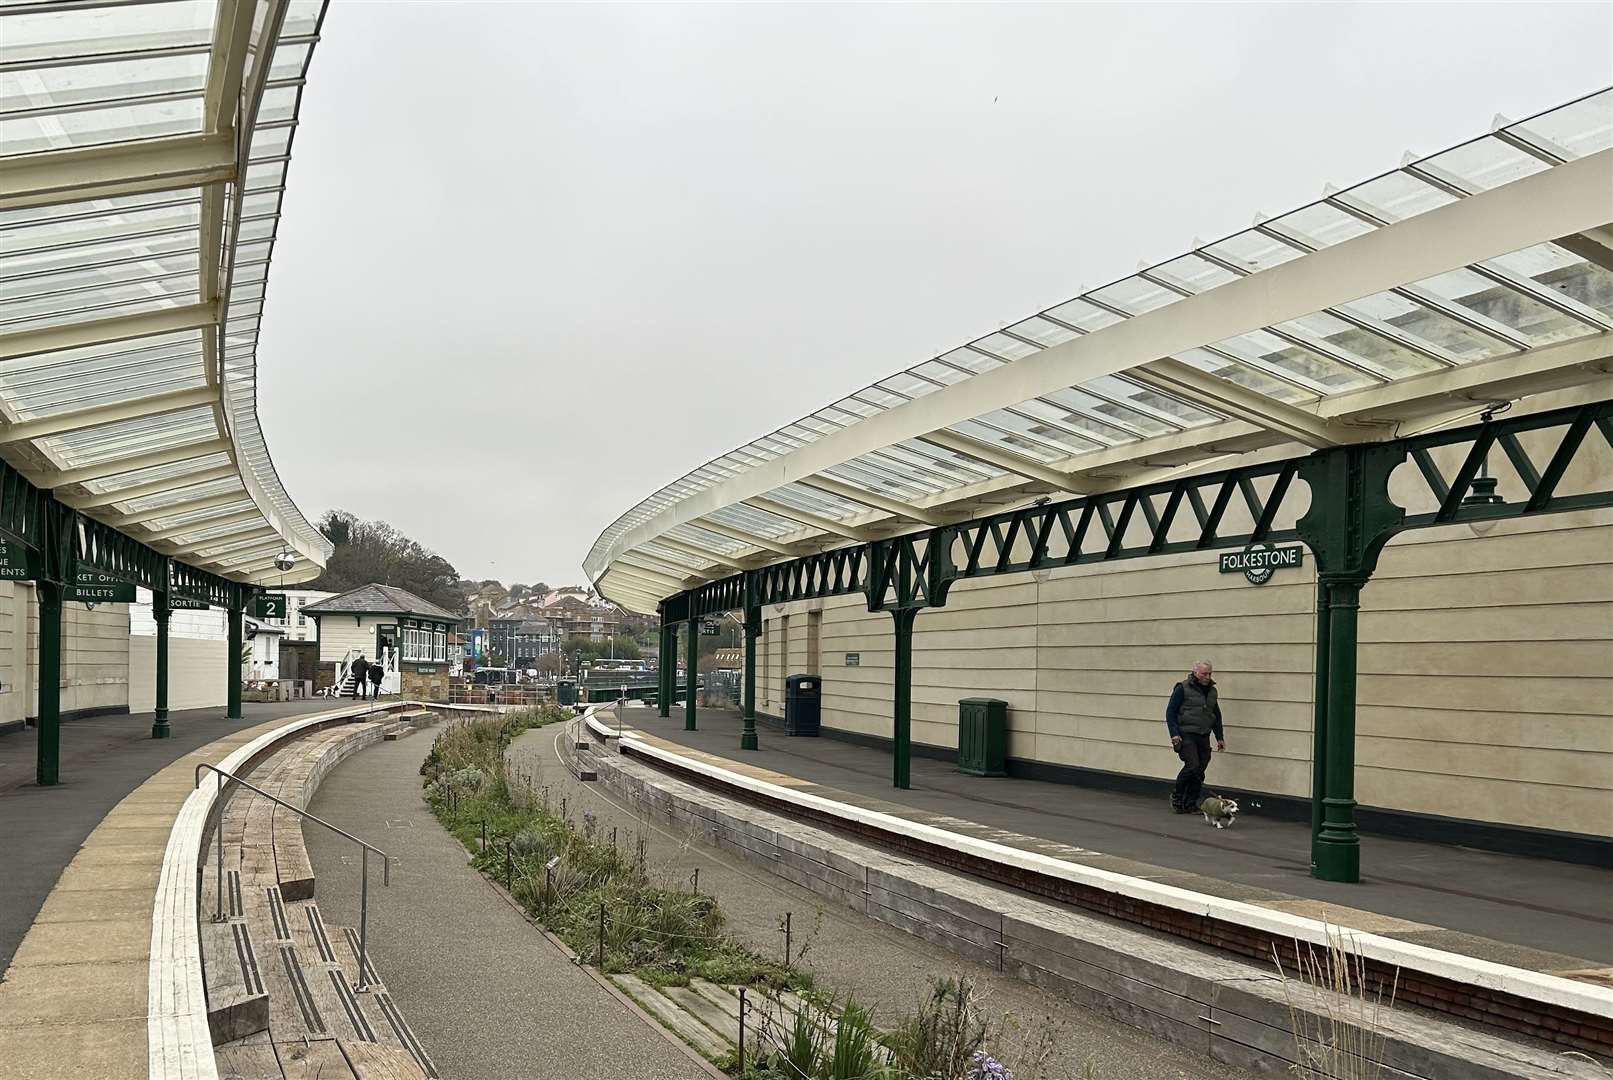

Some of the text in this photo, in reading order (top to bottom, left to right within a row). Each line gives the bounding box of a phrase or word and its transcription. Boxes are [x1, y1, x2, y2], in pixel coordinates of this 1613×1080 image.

[1223, 549, 1297, 569] FOLKESTONE
[1246, 568, 1272, 583] HARBOUR
[76, 589, 114, 597] BILLETS
[170, 599, 200, 608] SORTIE
[266, 602, 276, 615] 2
